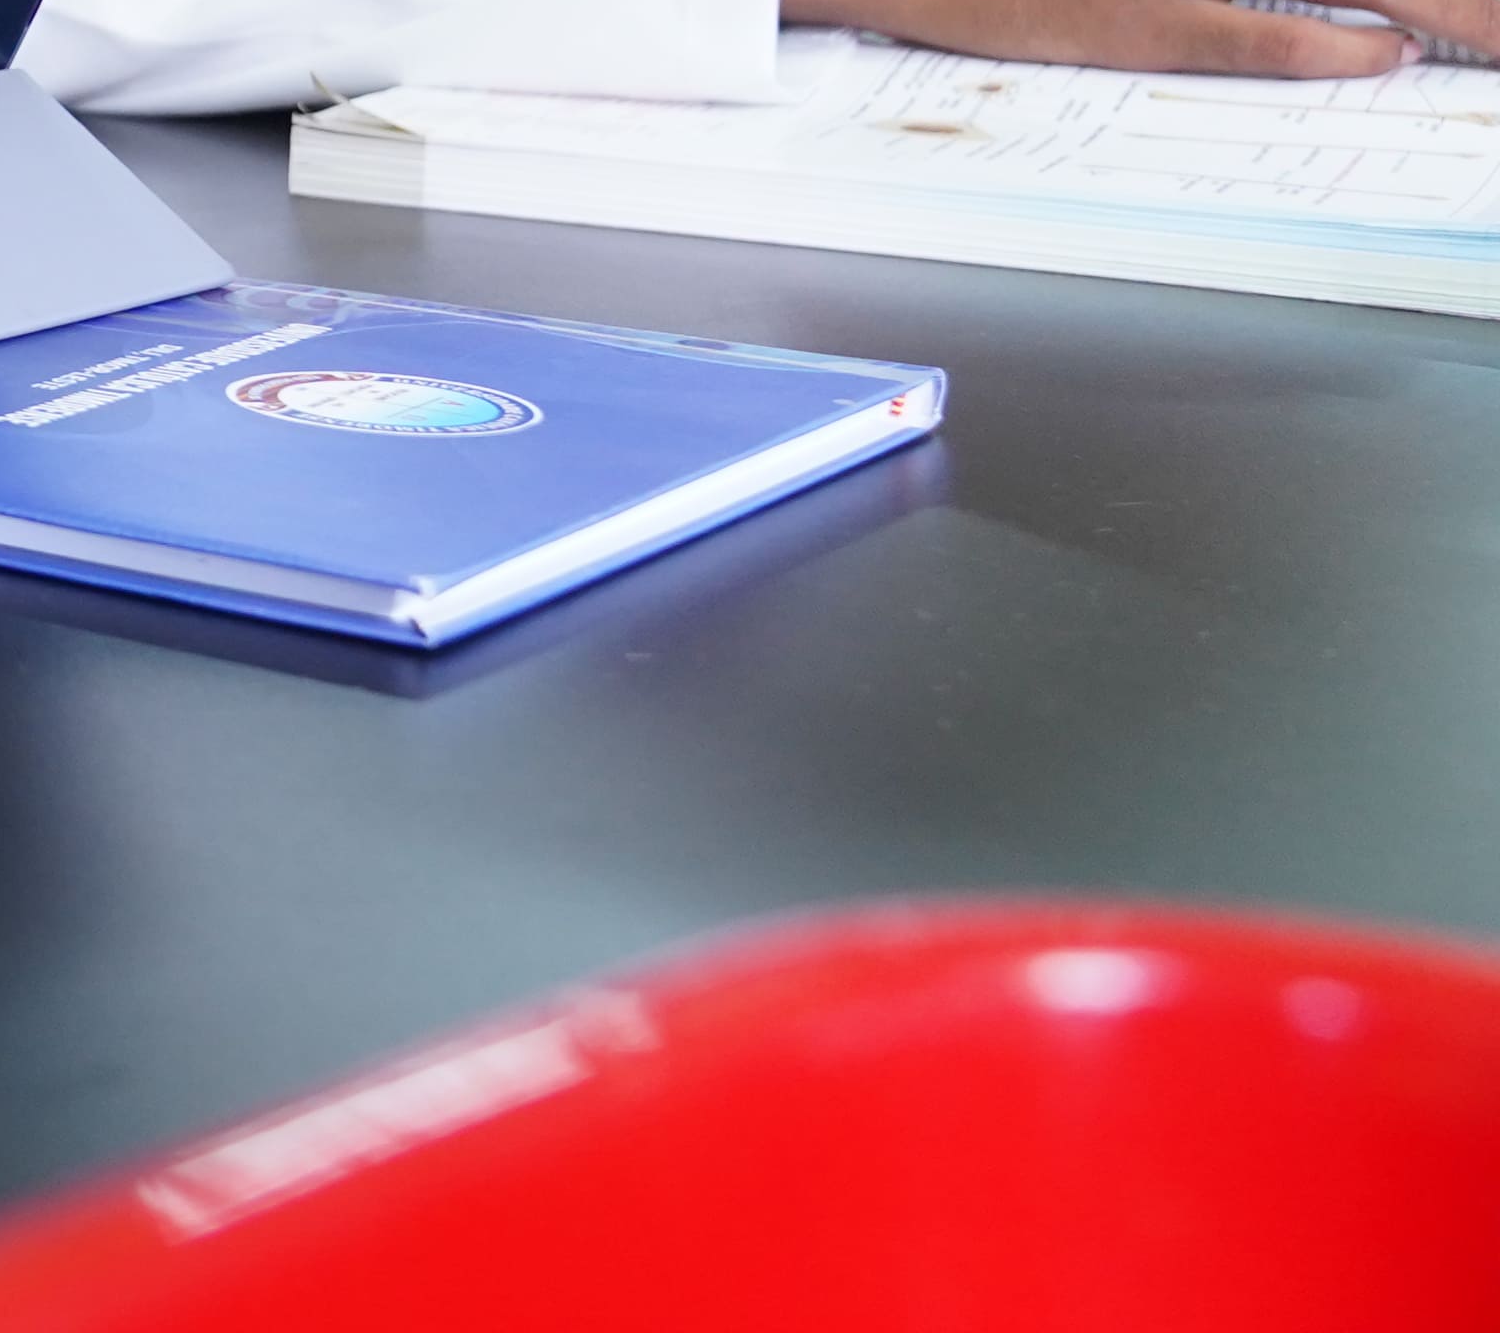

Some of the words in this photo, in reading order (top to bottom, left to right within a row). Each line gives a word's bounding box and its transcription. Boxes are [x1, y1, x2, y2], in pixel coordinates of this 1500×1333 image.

[184, 323, 333, 367] UNIVERSIDADE
[31, 352, 150, 390] TIMOR-LESTE
[99, 359, 214, 393] CATÓLICA
